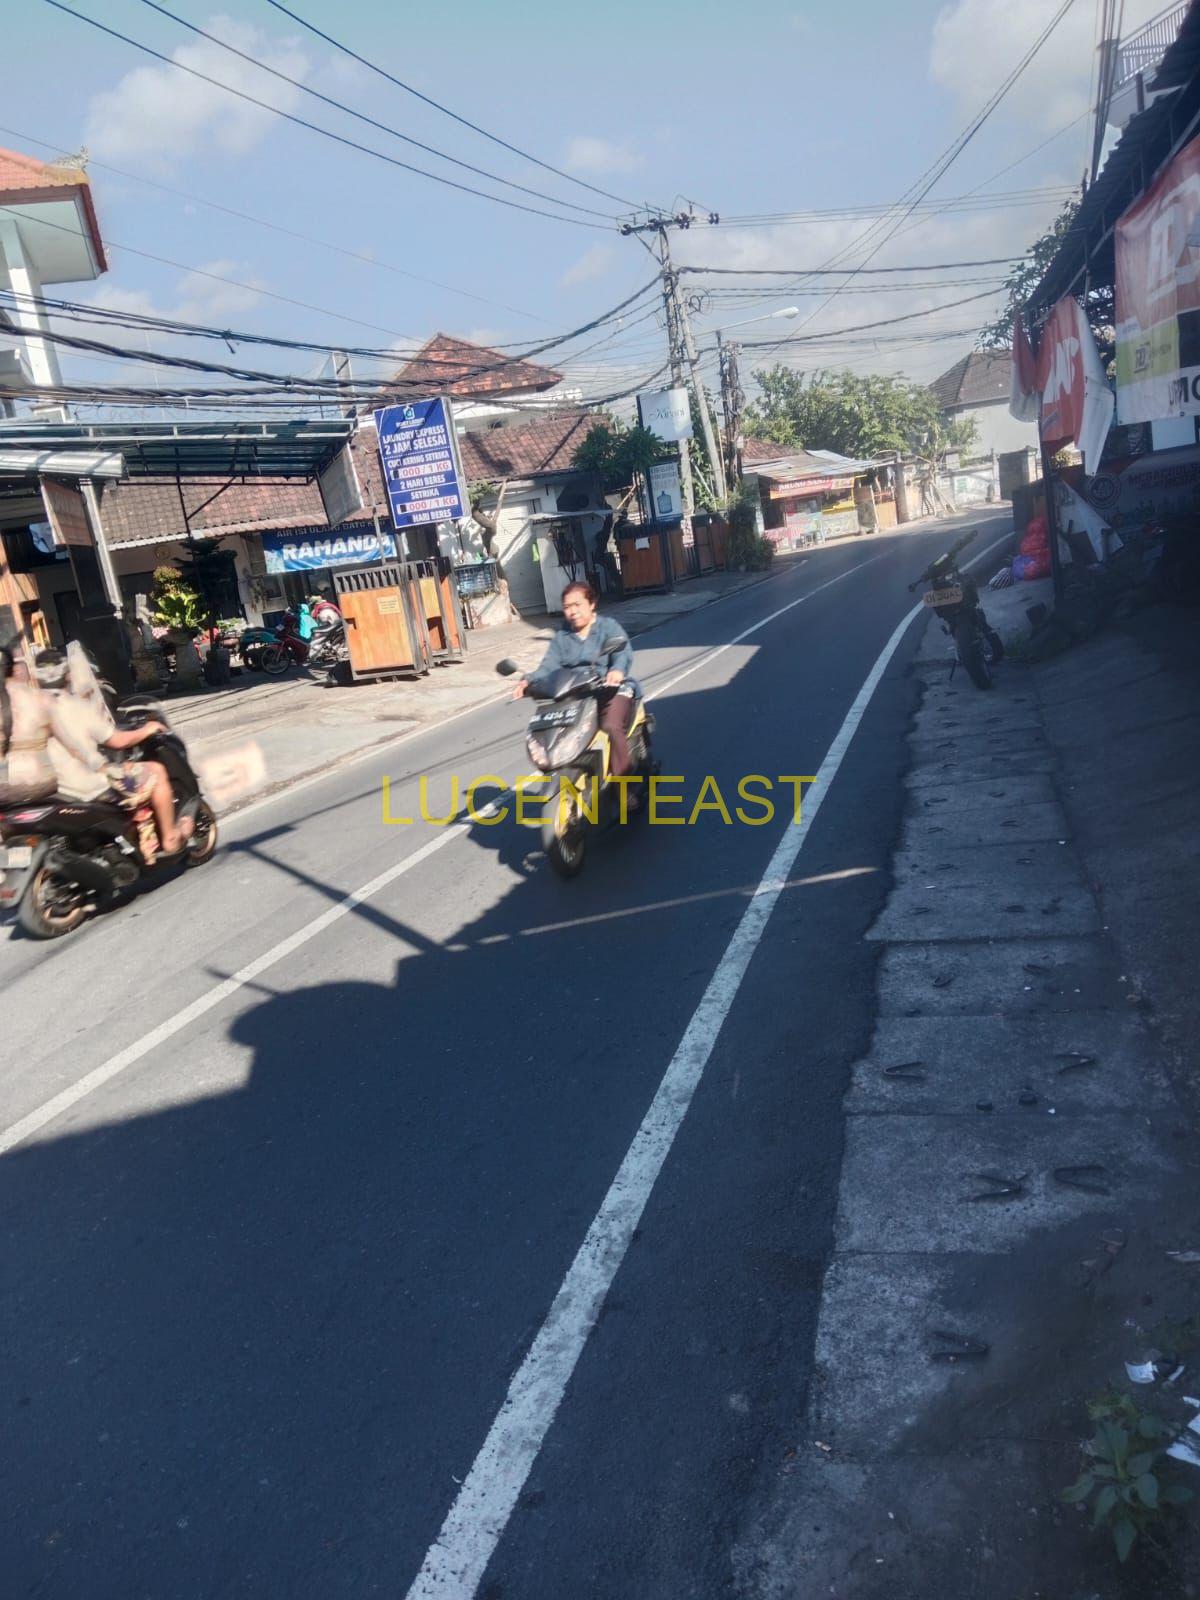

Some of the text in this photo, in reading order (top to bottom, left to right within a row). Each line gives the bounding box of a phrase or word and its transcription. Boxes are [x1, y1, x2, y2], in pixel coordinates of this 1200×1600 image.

[382, 430, 415, 445] LAUNDRY
[384, 434, 447, 455] 2 JAM SELESAI
[437, 461, 449, 471] KG
[400, 481, 406, 490] 2
[406, 478, 424, 489] HARI
[411, 487, 440, 500] SETRIKA
[444, 496, 455, 506] KG
[276, 527, 293, 538] AIR
[282, 532, 390, 560] RAMANDA
